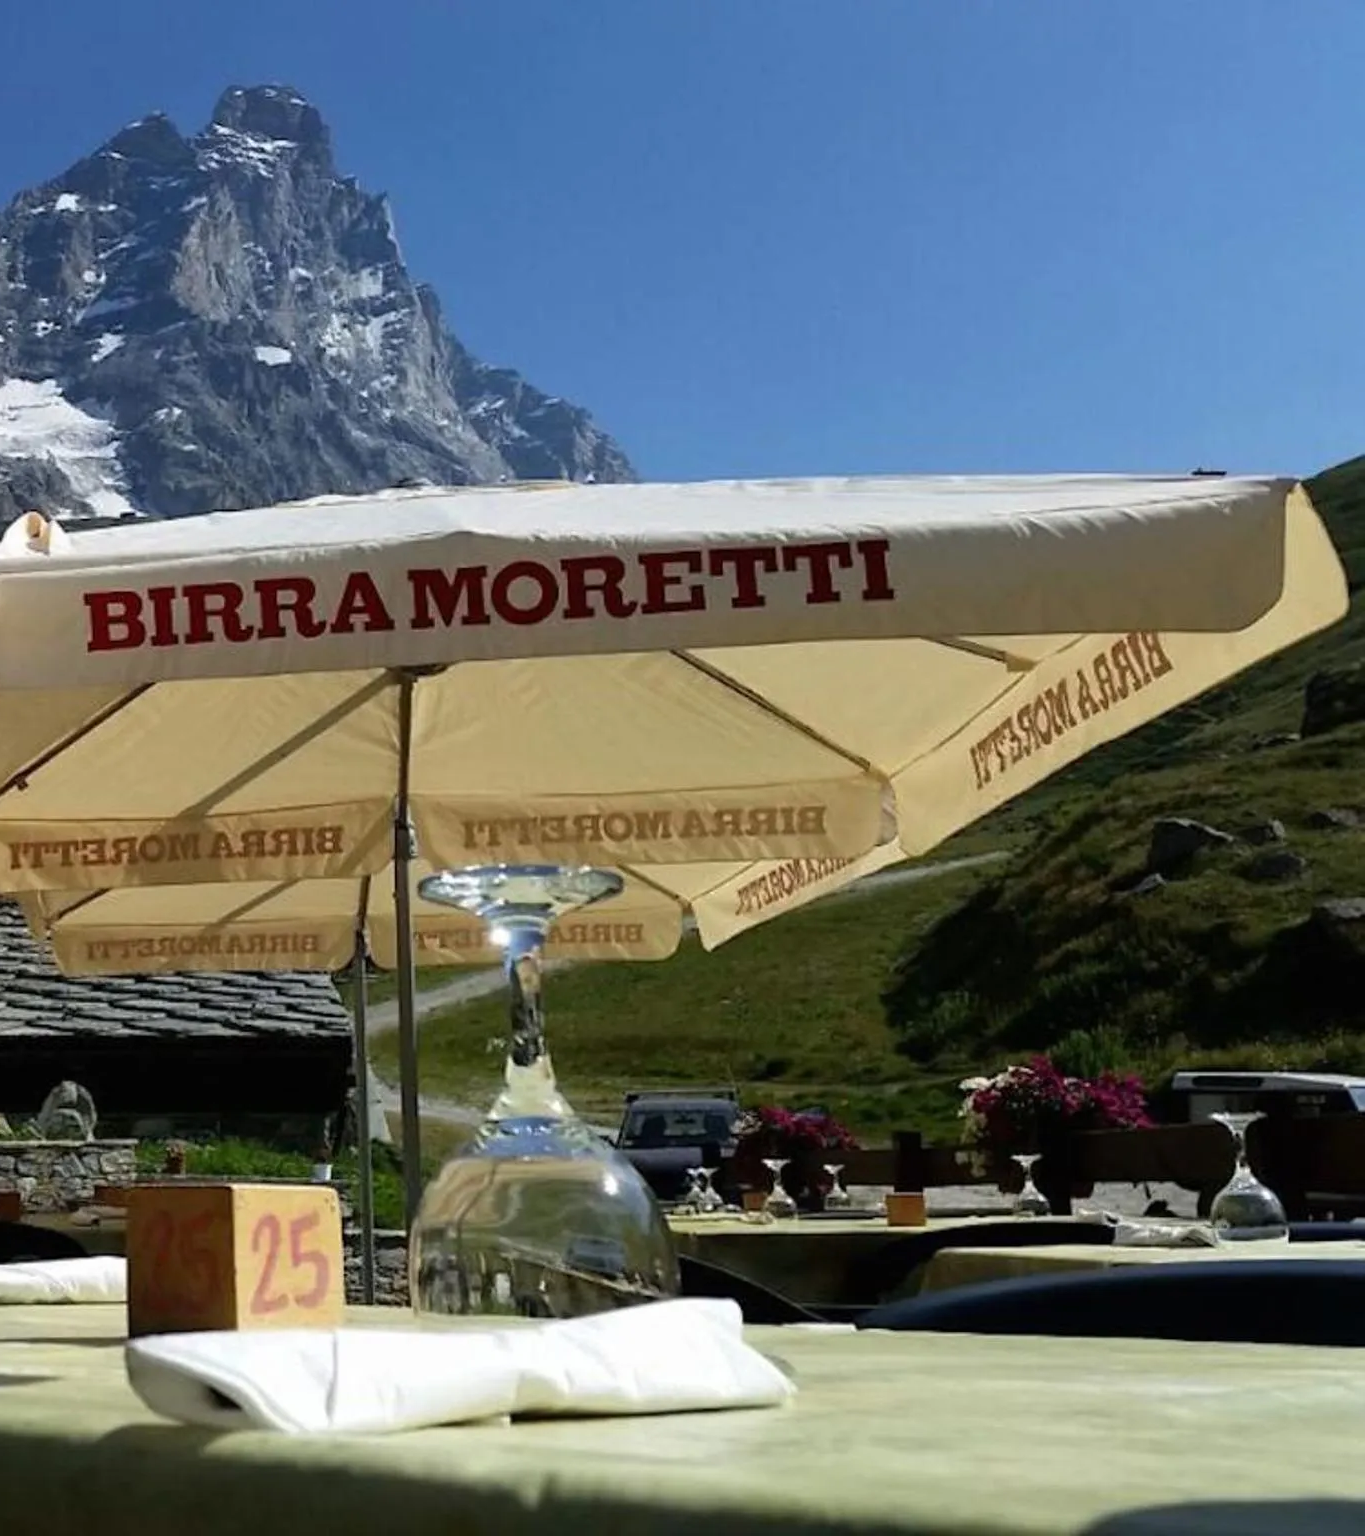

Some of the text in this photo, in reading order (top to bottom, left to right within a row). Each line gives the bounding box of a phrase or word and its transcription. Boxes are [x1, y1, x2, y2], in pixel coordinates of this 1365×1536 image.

[84, 539, 895, 652] BIRRA MORETTI
[250, 1211, 330, 1315] 25
